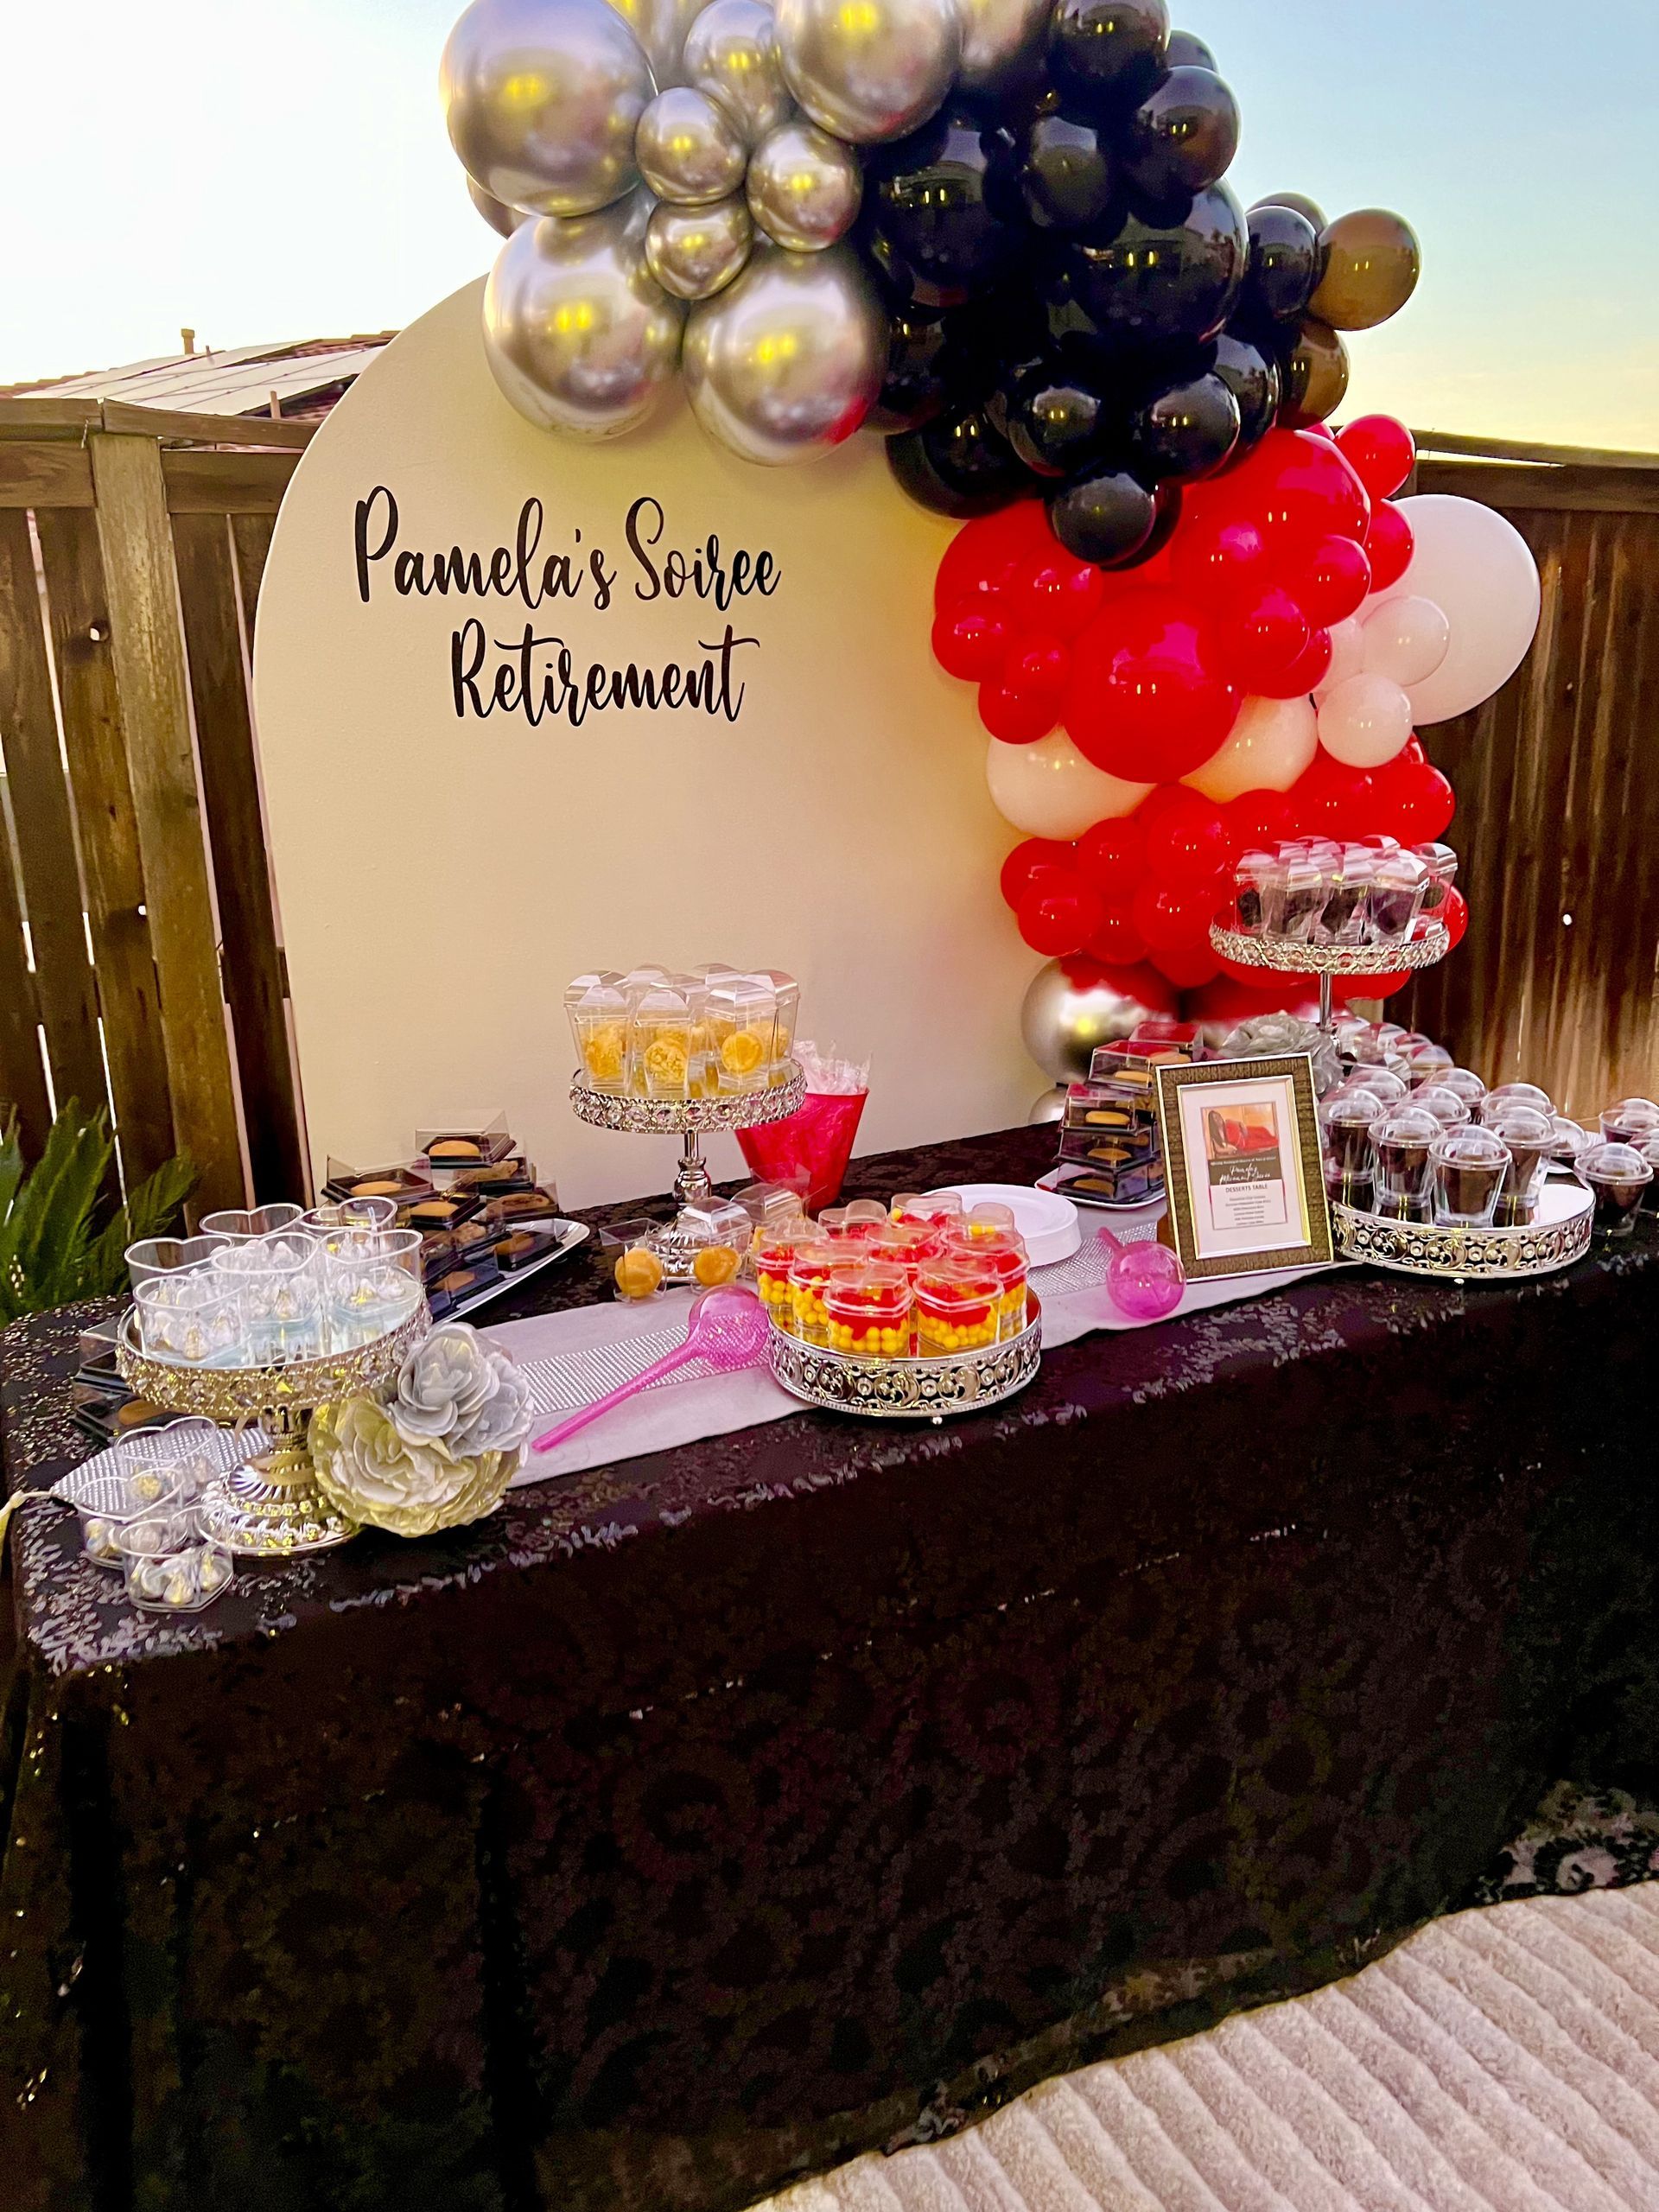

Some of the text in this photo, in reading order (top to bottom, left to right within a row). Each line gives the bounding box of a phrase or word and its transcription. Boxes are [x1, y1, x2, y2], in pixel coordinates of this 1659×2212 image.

[354, 485, 782, 612] Pamela's Soiree
[451, 618, 760, 728] Retirement
